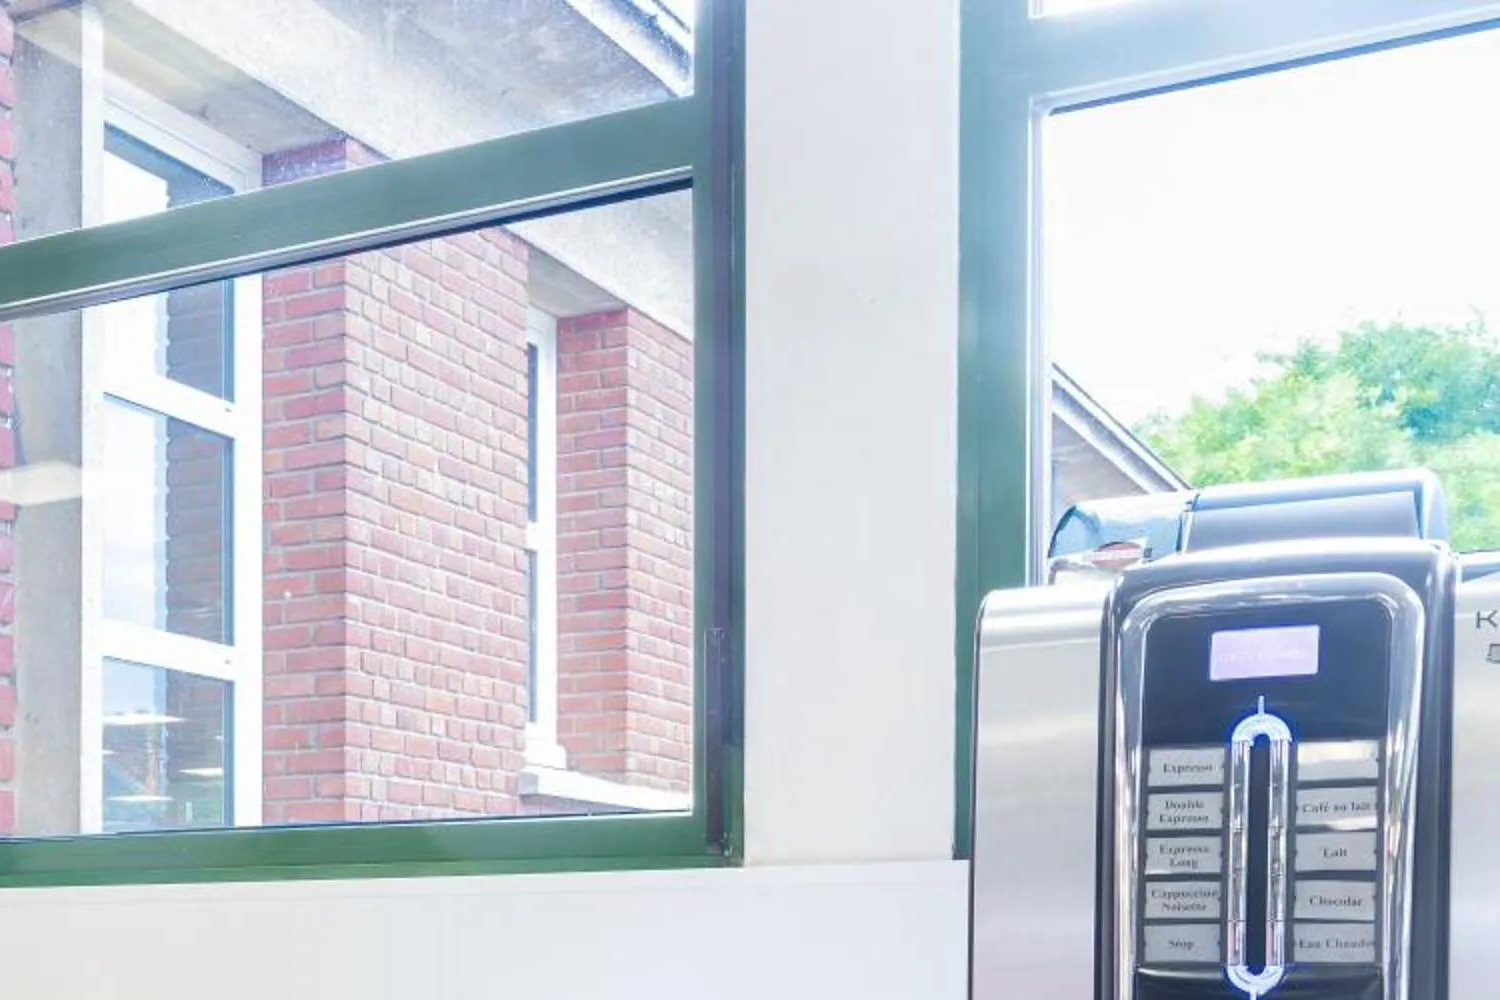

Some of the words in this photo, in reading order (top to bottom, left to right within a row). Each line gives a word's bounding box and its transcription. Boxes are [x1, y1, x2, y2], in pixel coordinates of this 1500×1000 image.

[1302, 801, 1330, 813] Café
[1351, 800, 1371, 811] lait
[1323, 847, 1348, 858] Lait
